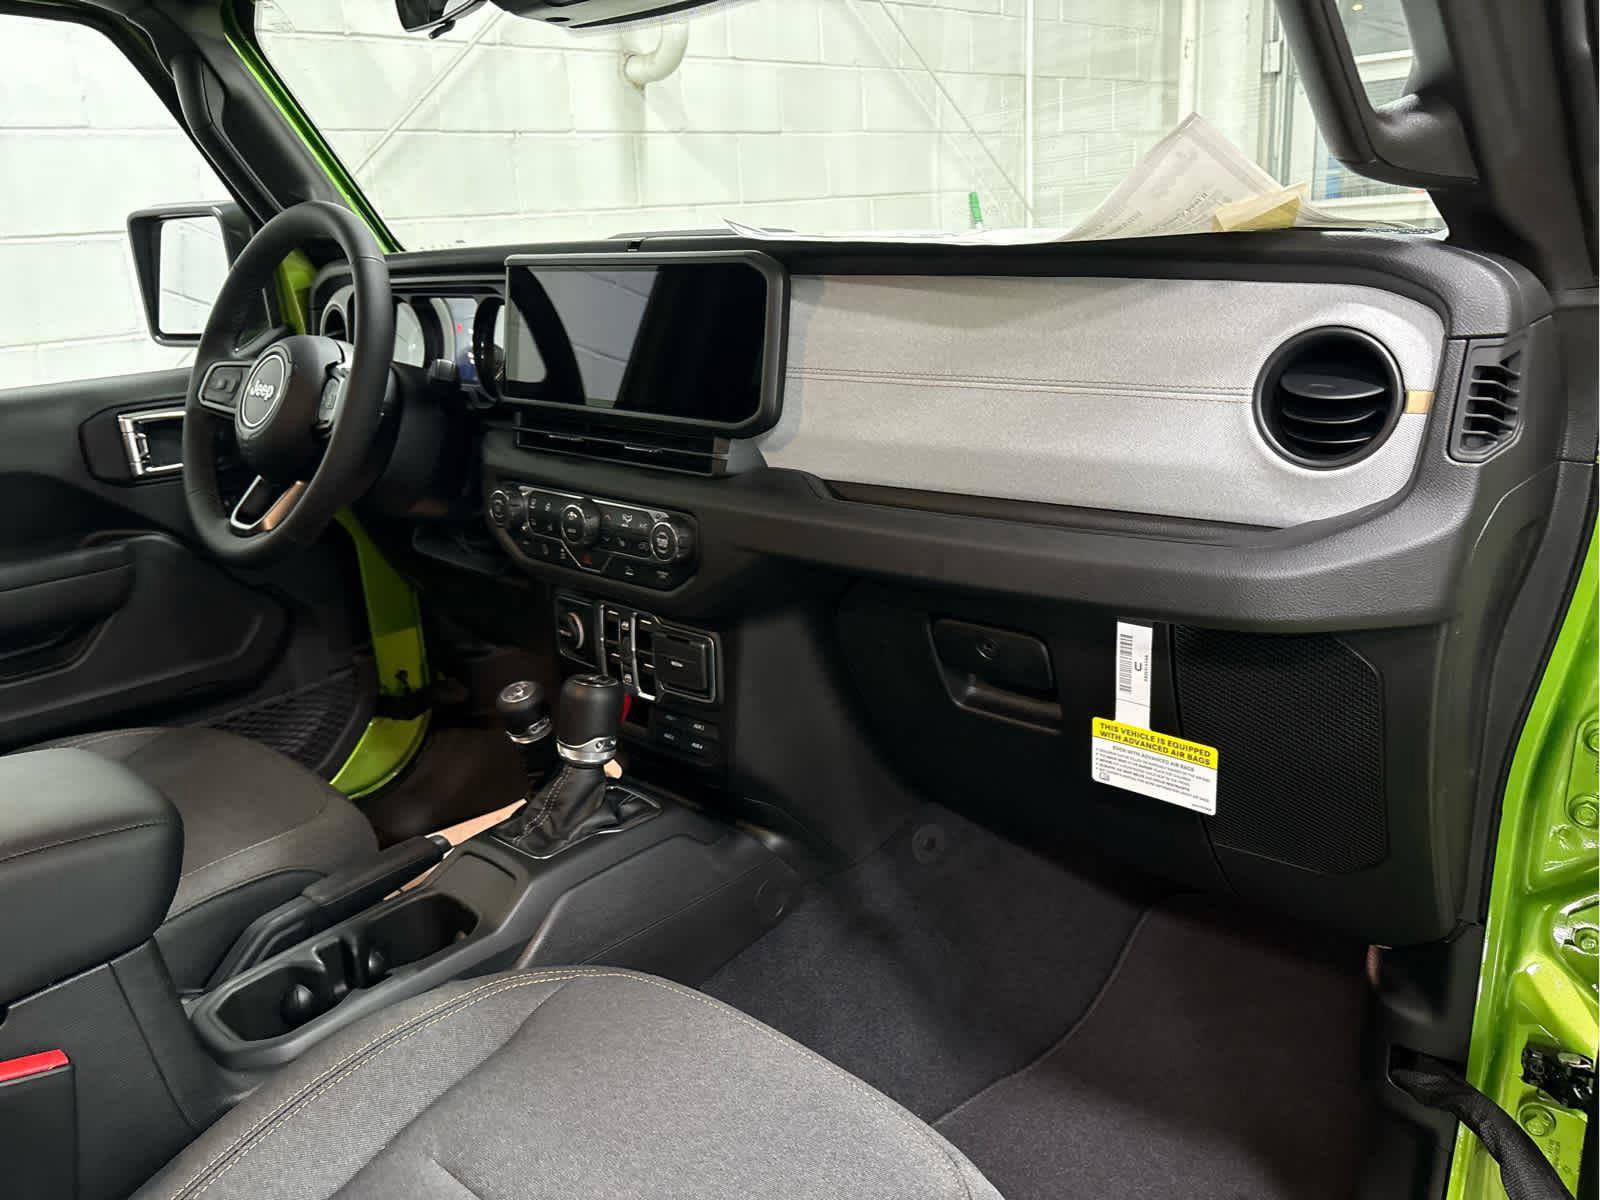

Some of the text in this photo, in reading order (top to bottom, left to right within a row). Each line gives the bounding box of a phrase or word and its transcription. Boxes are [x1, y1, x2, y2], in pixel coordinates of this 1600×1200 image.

[250, 380, 274, 401] Jeep
[1100, 722, 1211, 758] THIS VEHICLE IS EQUIPPED
[1100, 730, 1210, 766] WITH ADVANCED AIR BAGS
